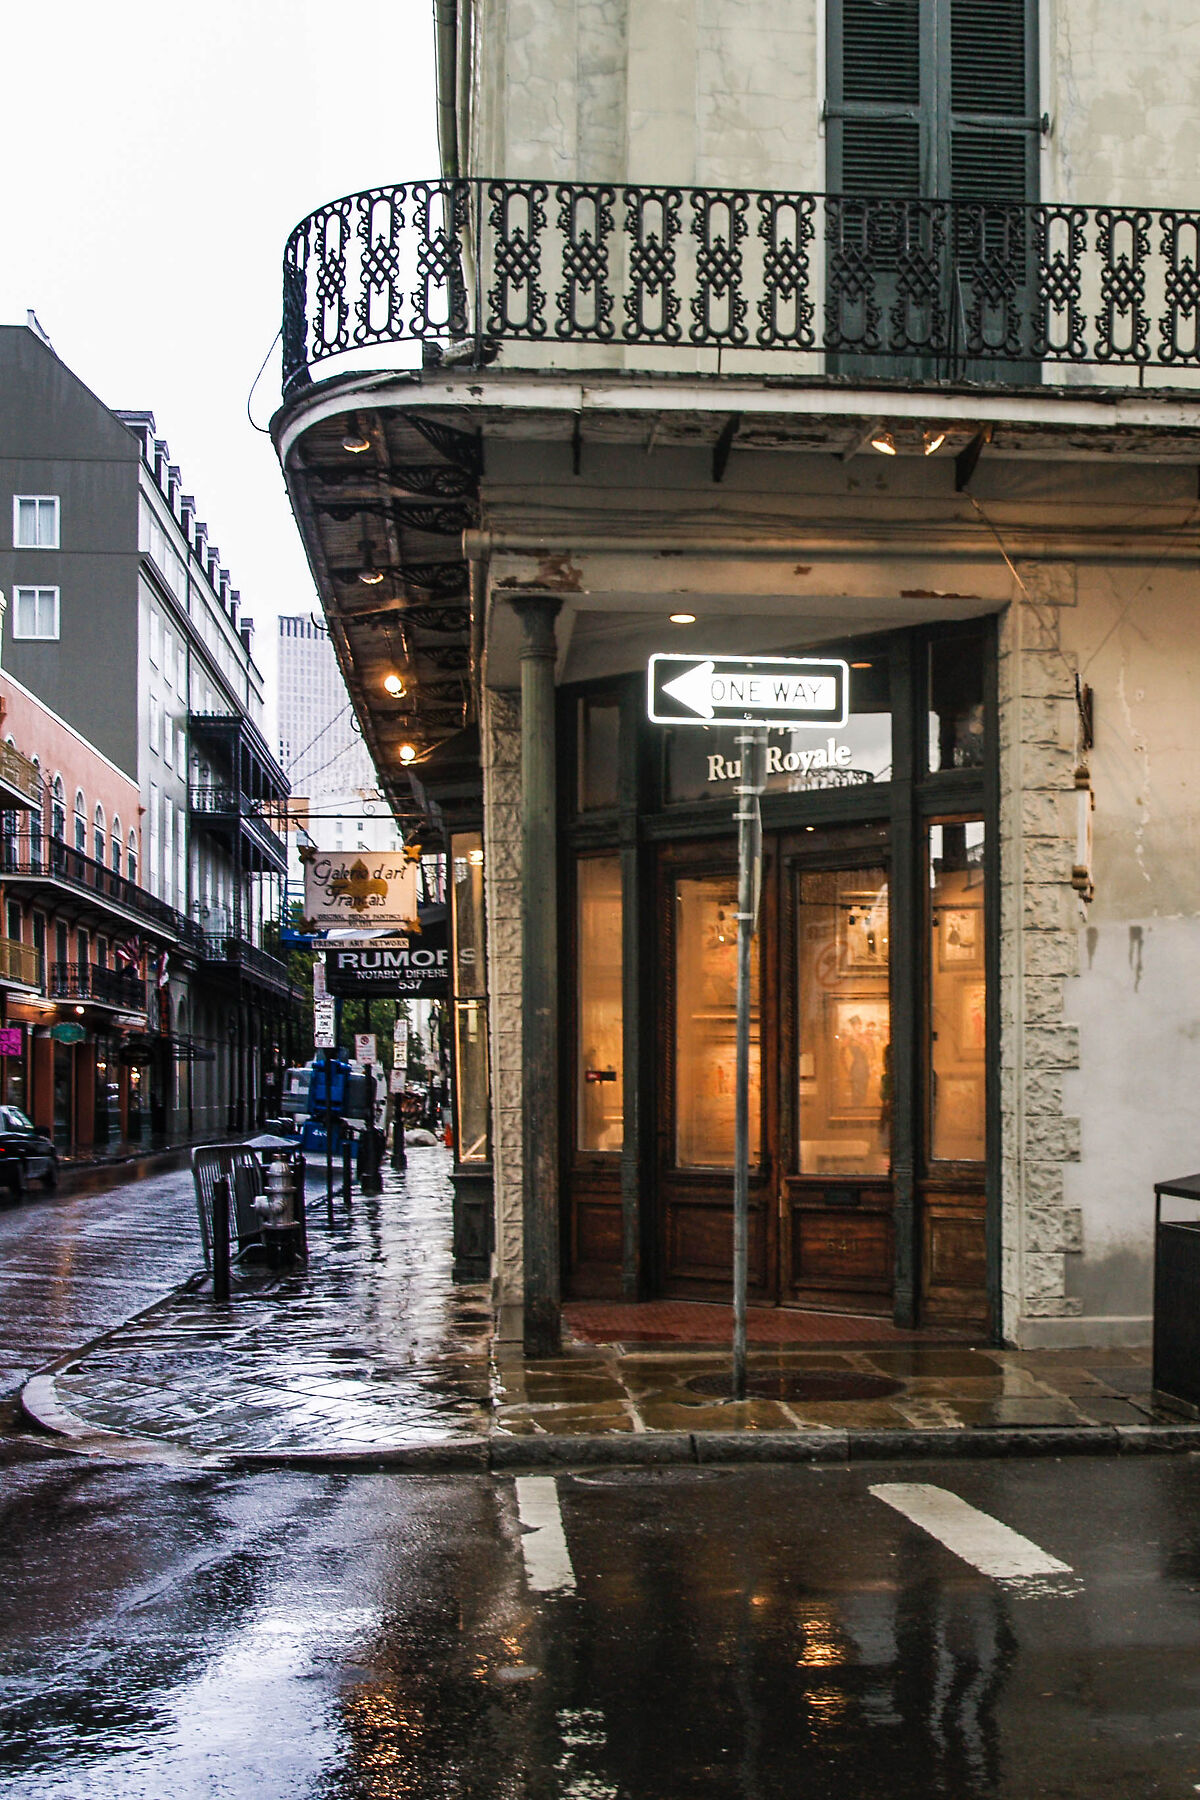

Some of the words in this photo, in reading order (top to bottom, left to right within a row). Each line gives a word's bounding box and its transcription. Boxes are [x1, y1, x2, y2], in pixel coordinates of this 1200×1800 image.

[711, 680, 761, 702] ONE
[773, 682, 822, 703] WAY
[707, 754, 742, 781] Ru
[766, 738, 852, 776] Royale
[313, 859, 368, 886] Galerie
[369, 939, 408, 947] NETWORK
[406, 968, 448, 978] DIFFERE
[398, 979, 423, 990] 537
